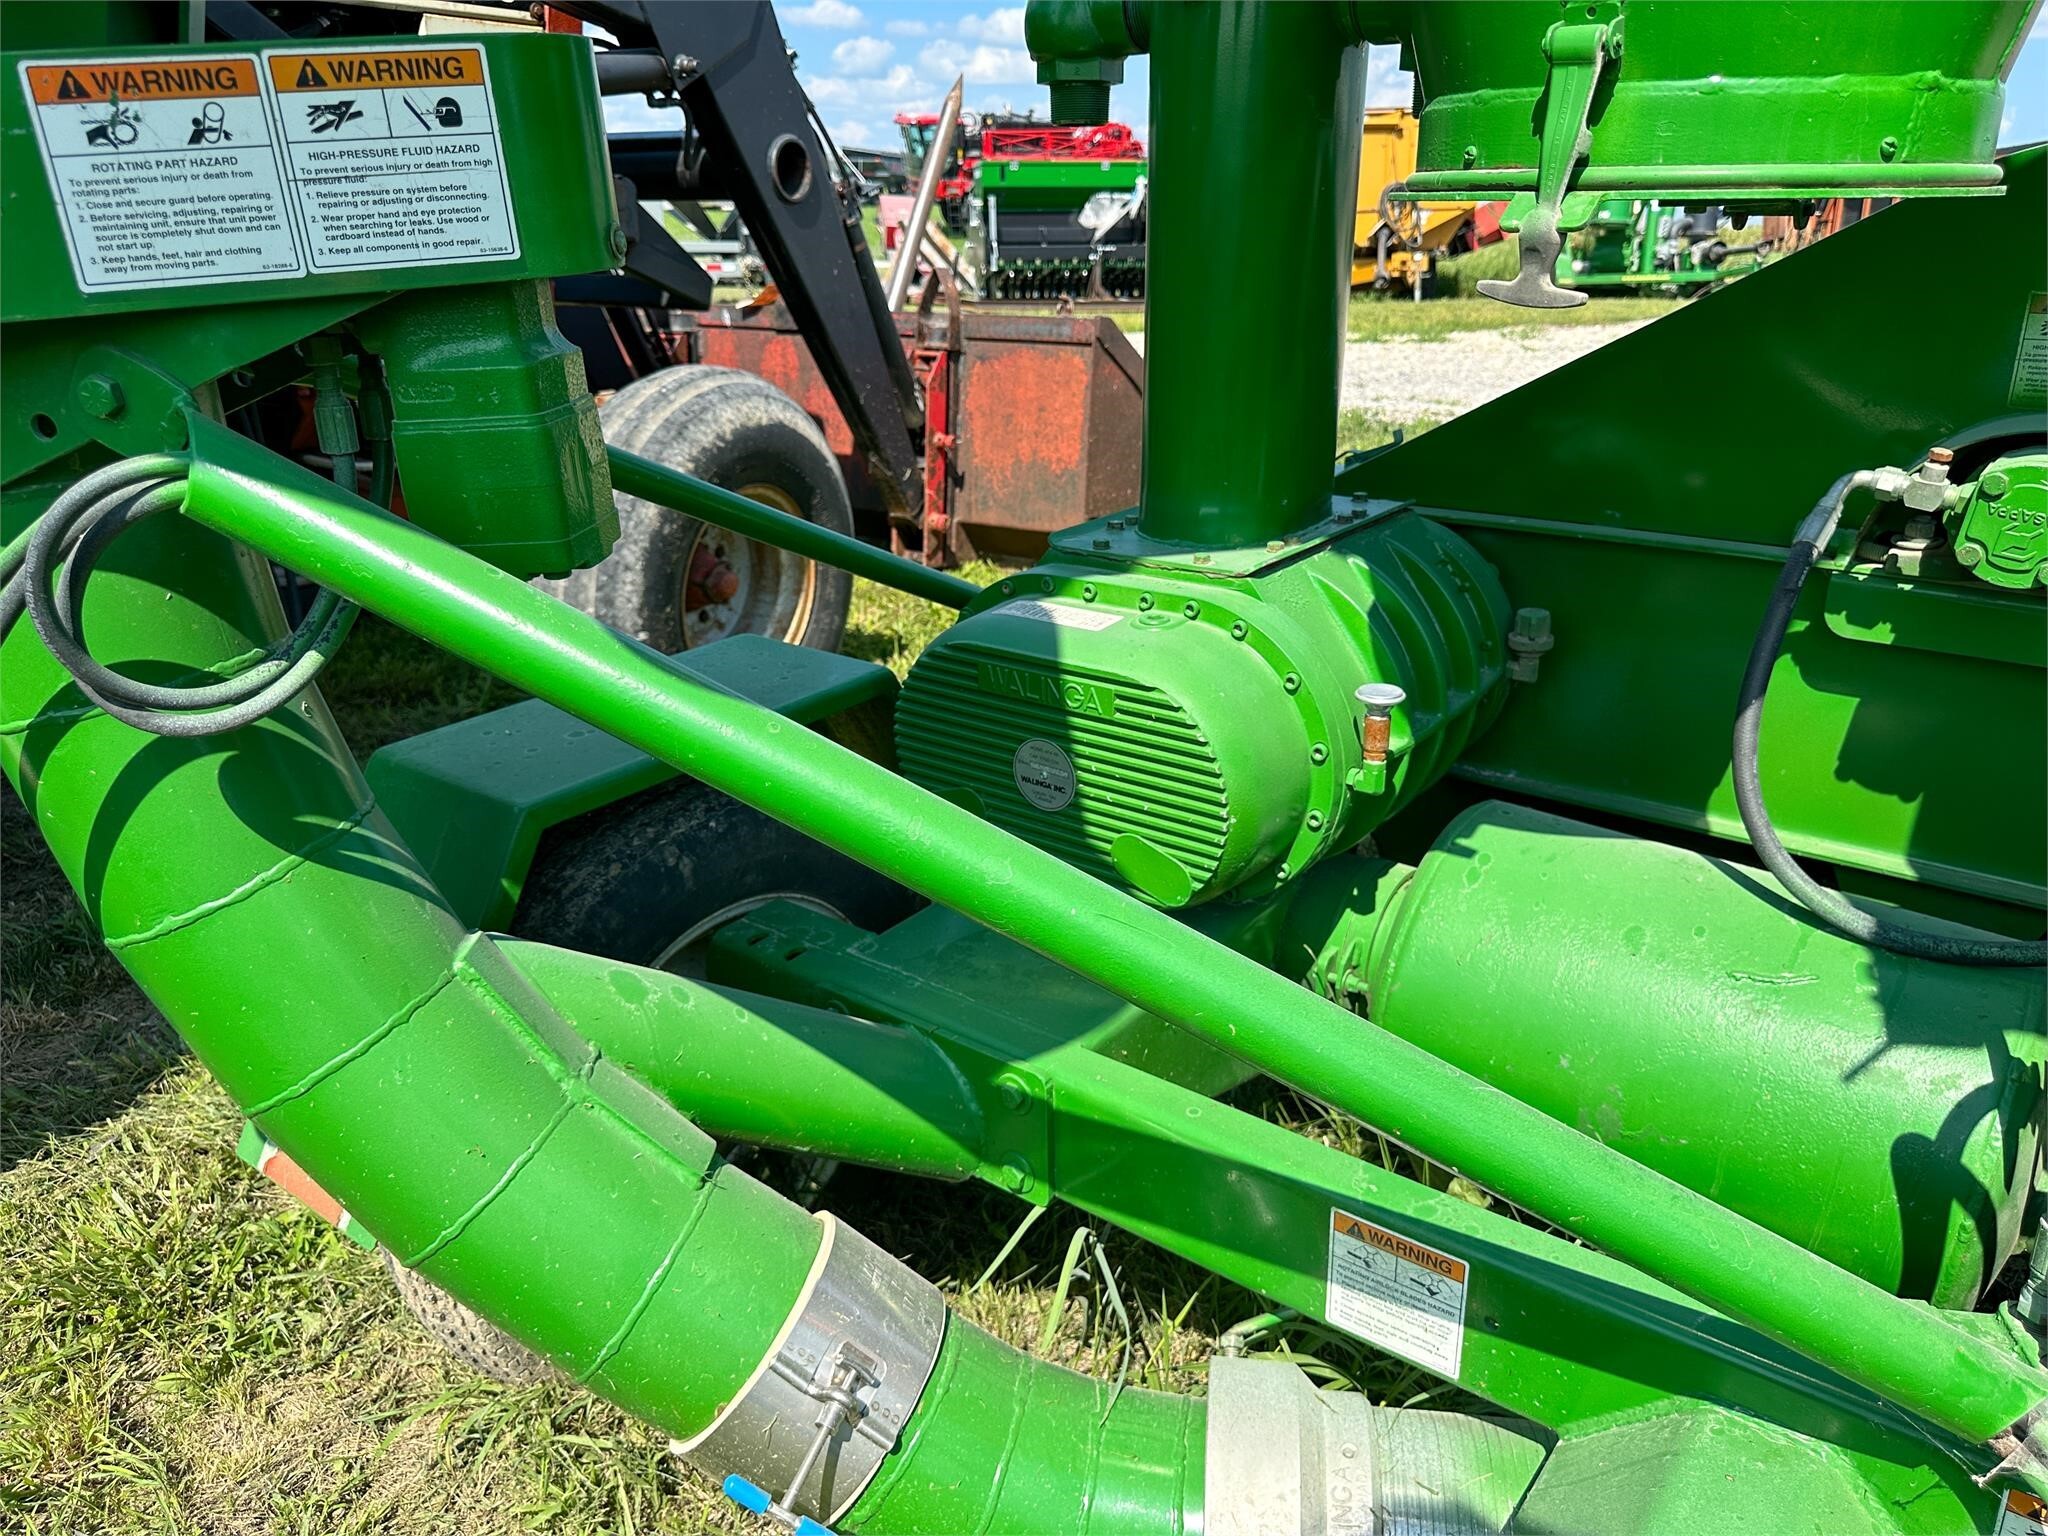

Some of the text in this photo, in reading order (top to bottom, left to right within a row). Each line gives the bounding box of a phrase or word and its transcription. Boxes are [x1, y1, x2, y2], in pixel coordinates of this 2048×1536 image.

[328, 56, 464, 83] WARNING
[91, 67, 238, 94] WARNING
[308, 144, 480, 161] HIGH-PRESSURE FLUID HAZARD
[91, 156, 238, 173] ROTATING PART HAZARD
[315, 166, 349, 176] prevent
[351, 164, 384, 173] serious
[386, 163, 411, 172] injury
[474, 159, 493, 168] high
[69, 179, 82, 188] To
[85, 178, 121, 188] prevent
[124, 176, 159, 184] serious
[162, 174, 188, 183] injury
[203, 171, 229, 180] death
[304, 177, 342, 187] pressure
[72, 186, 140, 198] rotating parts:
[316, 191, 349, 199] Relieve
[351, 189, 390, 198] pressure
[406, 186, 437, 195] system
[318, 200, 358, 209] repairing
[372, 197, 413, 206] adjusting
[427, 192, 489, 202] disconnecting.
[86, 201, 113, 210] Close
[169, 196, 194, 206] guard
[197, 195, 226, 203] before
[229, 192, 273, 202] operating.
[90, 214, 122, 222] Before
[124, 211, 170, 220] servicing,
[173, 208, 219, 218] adjusting,
[221, 205, 263, 215] repairing
[347, 212, 375, 222] proper
[438, 206, 482, 216] protection
[93, 222, 149, 232] maintaining
[151, 220, 172, 228] unit,
[174, 219, 206, 227] ensure
[209, 216, 226, 224] that
[249, 214, 276, 223] power
[350, 221, 392, 230] searching
[96, 234, 128, 242] source
[142, 229, 192, 238] completely
[195, 227, 216, 235] shut
[218, 225, 243, 234] down
[245, 224, 262, 232] and
[326, 232, 370, 241] cardboard
[373, 229, 404, 238] instead
[116, 242, 138, 250] start
[140, 242, 155, 250] up.
[366, 243, 420, 252] components
[433, 240, 454, 249] good
[456, 238, 484, 247] repair.
[102, 256, 126, 265] Keep
[128, 254, 159, 263] hands,
[162, 252, 183, 260] feet,
[185, 250, 201, 258] hair
[205, 248, 222, 256] and
[224, 246, 262, 256] clothing
[104, 259, 218, 274] away from moving parts.
[987, 664, 1104, 716] WALINGA
[1020, 775, 1052, 790] WALINGA
[1368, 1229, 1452, 1274] WARNING
[1427, 1302, 1455, 1317] HAZARD
